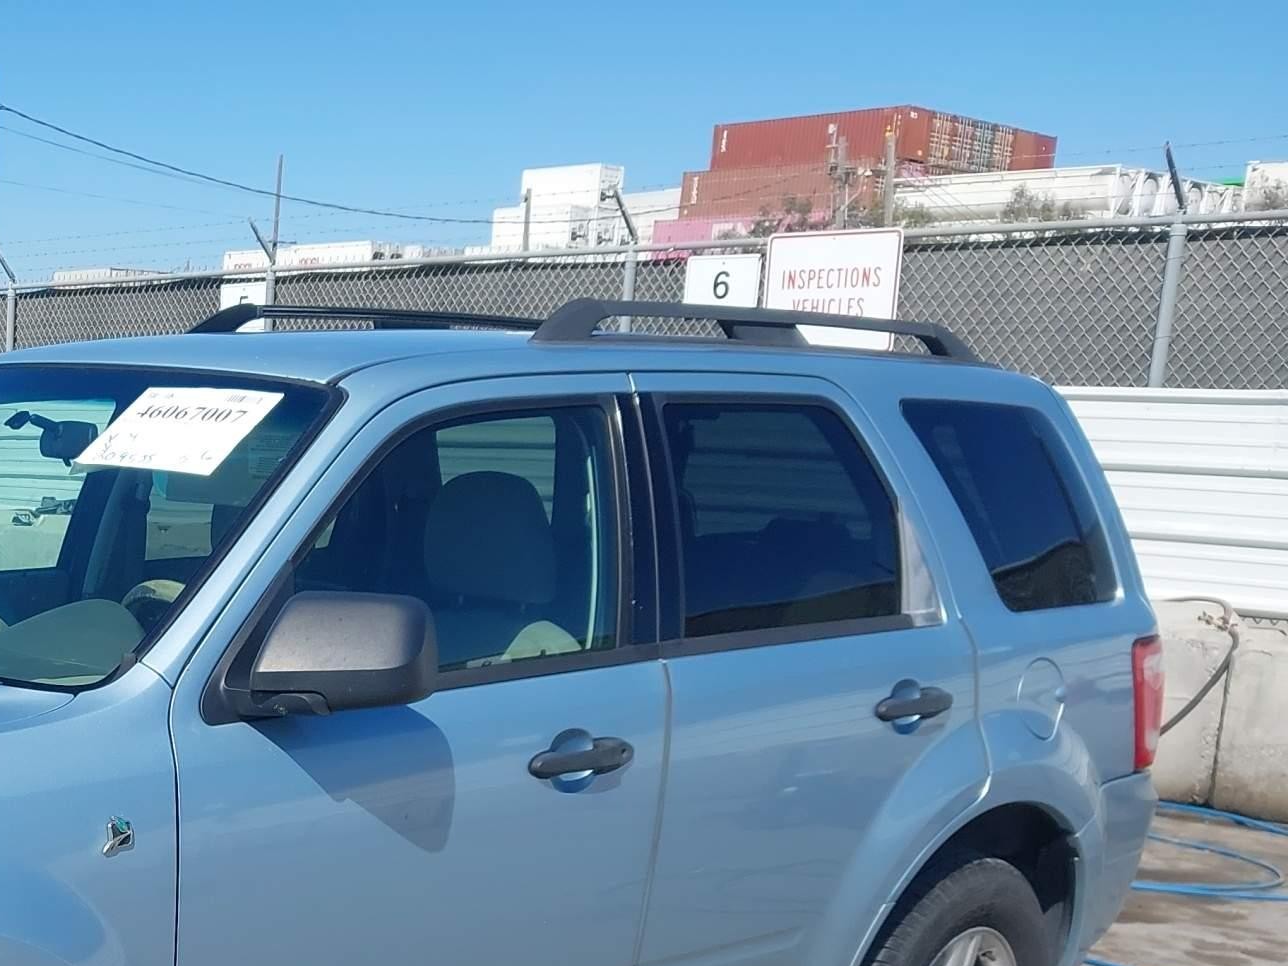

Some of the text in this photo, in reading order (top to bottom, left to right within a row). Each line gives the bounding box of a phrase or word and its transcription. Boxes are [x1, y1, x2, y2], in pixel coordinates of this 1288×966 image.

[713, 271, 730, 299] 6
[781, 266, 882, 290] INSPECTIONS
[792, 297, 865, 318] VEHICLES
[136, 404, 248, 423] 46067007
